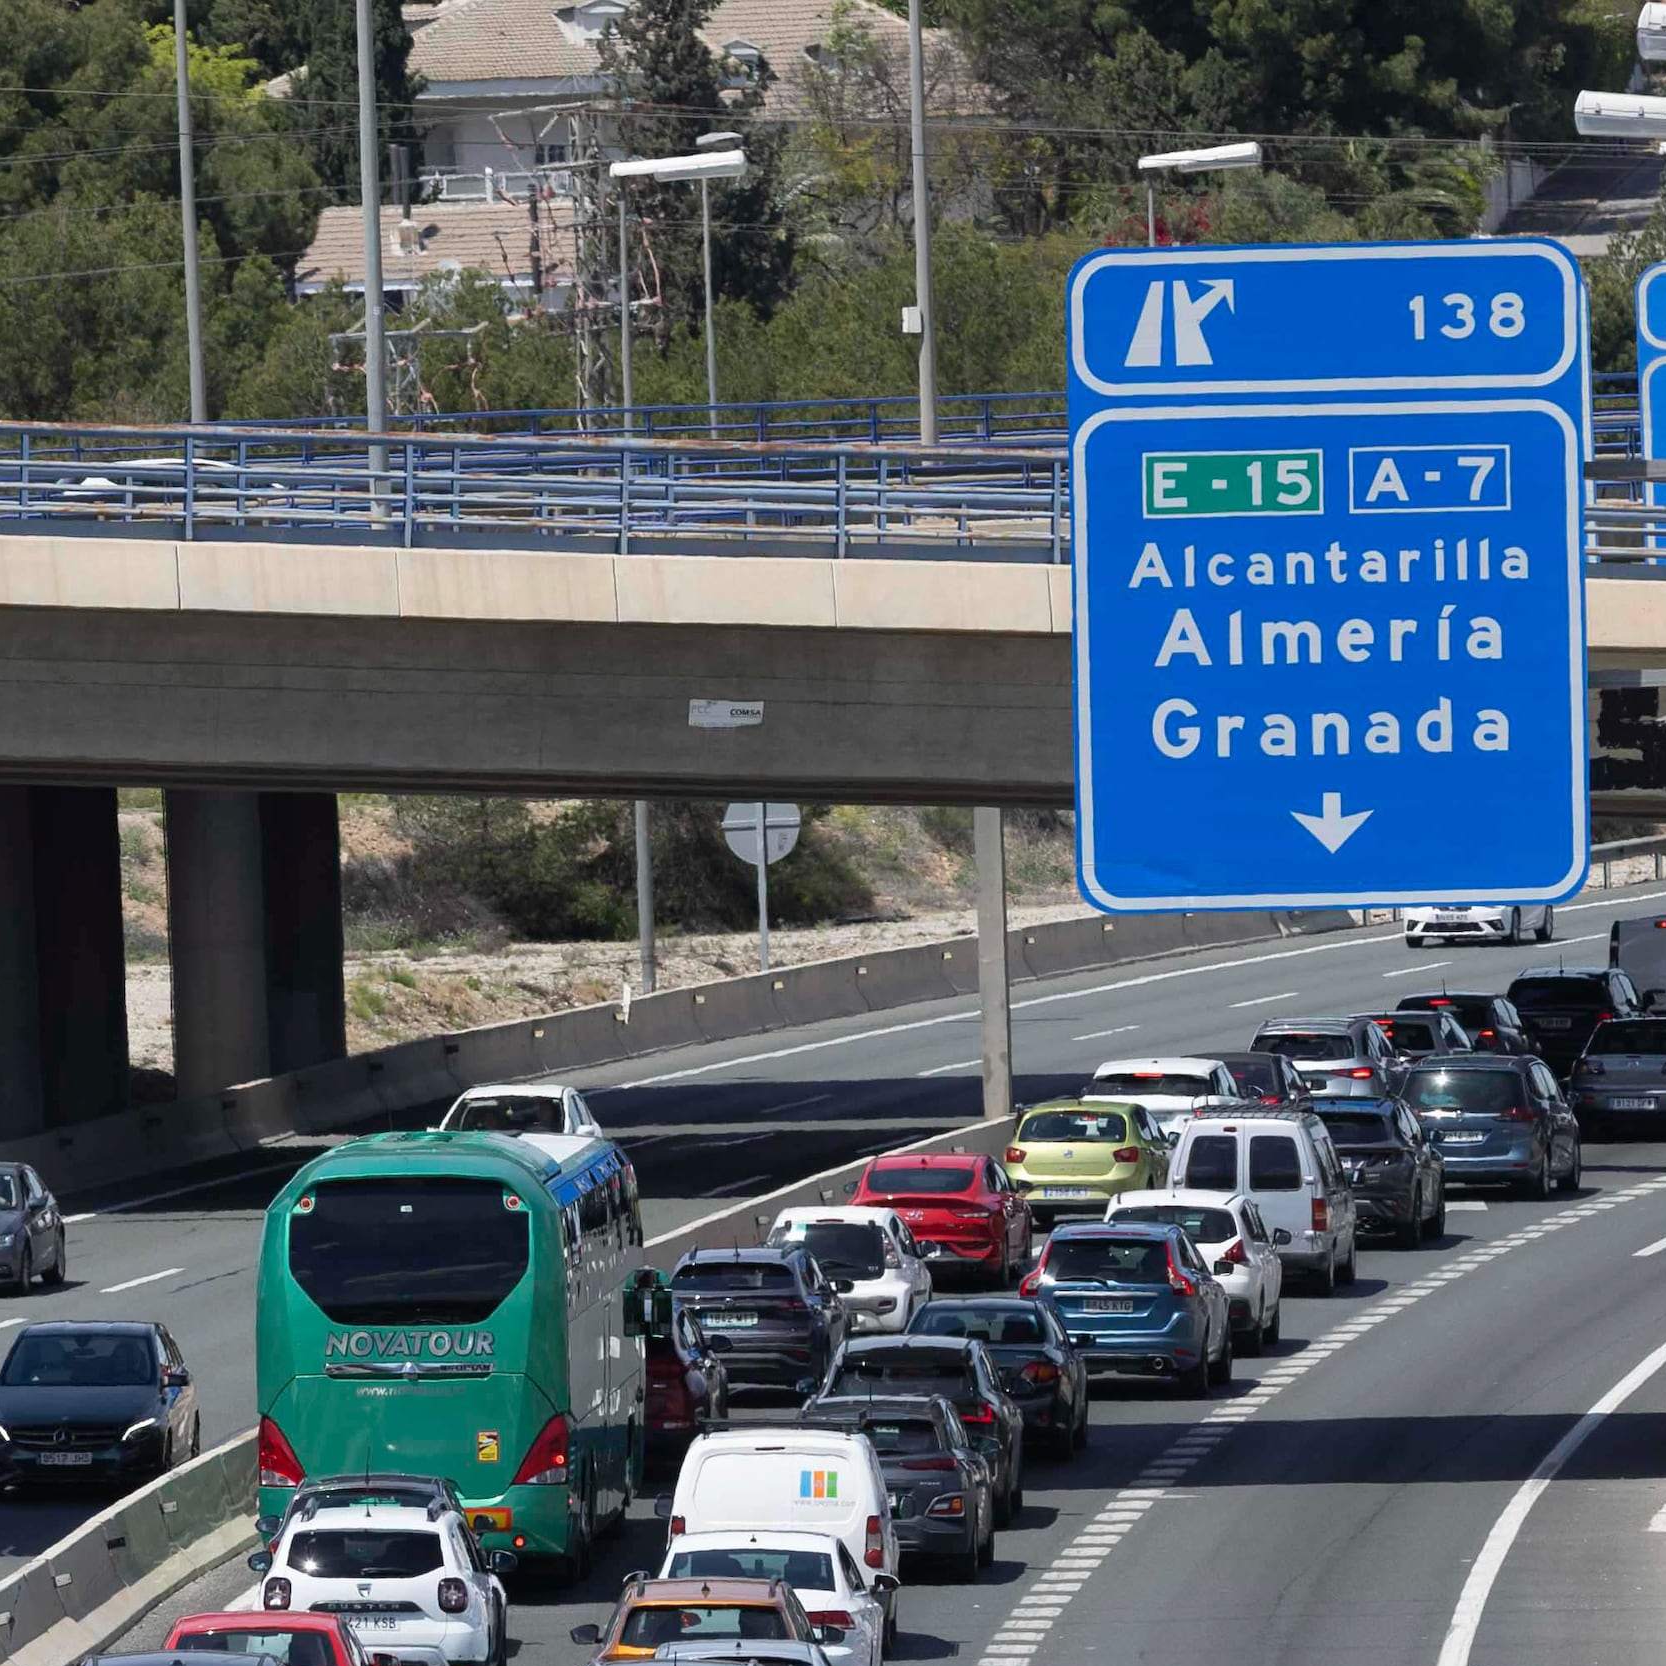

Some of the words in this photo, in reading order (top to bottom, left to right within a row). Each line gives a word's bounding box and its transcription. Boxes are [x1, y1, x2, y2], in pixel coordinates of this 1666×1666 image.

[1409, 291, 1526, 341] 138
[1153, 459, 1312, 509] E-15
[1365, 456, 1496, 502] A-7
[1128, 537, 1529, 589] Alcantarilla
[1154, 603, 1503, 667] Almería
[729, 708, 761, 716] COMSA
[1152, 696, 1510, 760] Granada
[324, 1330, 495, 1358] NOVATOUR
[373, 1616, 397, 1629] KSB
